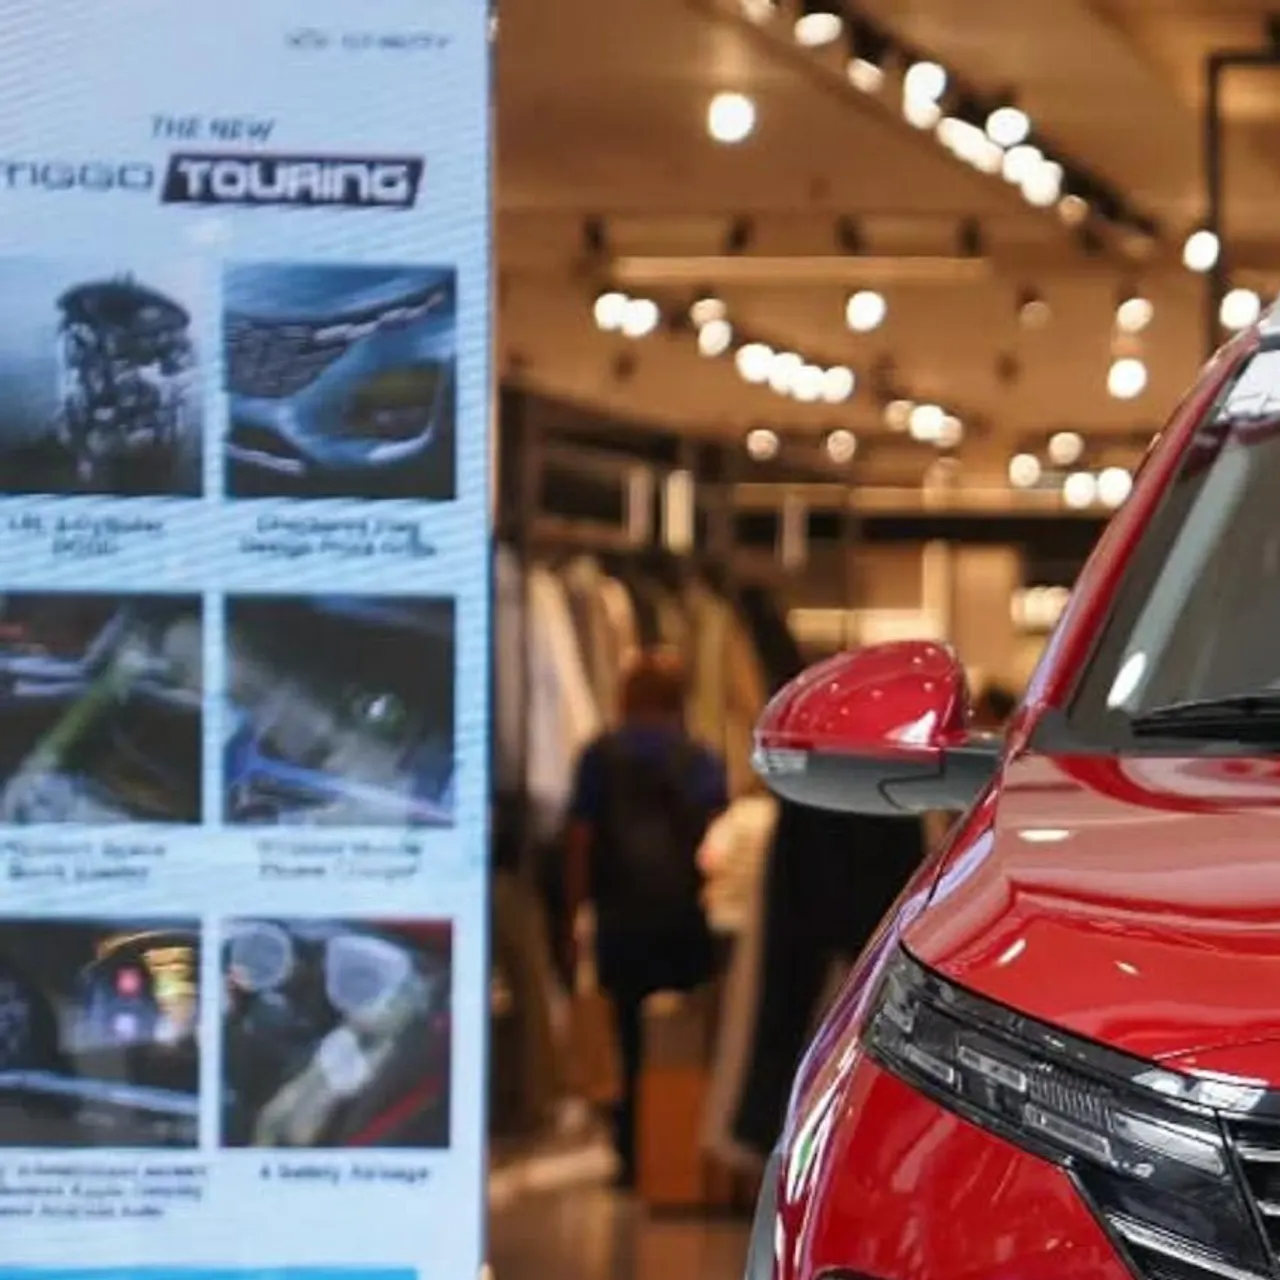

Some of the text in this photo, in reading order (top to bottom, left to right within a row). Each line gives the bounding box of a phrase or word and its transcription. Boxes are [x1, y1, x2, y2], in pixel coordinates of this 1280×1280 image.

[150, 114, 276, 142] THE NEW
[176, 159, 410, 199] TOURING
